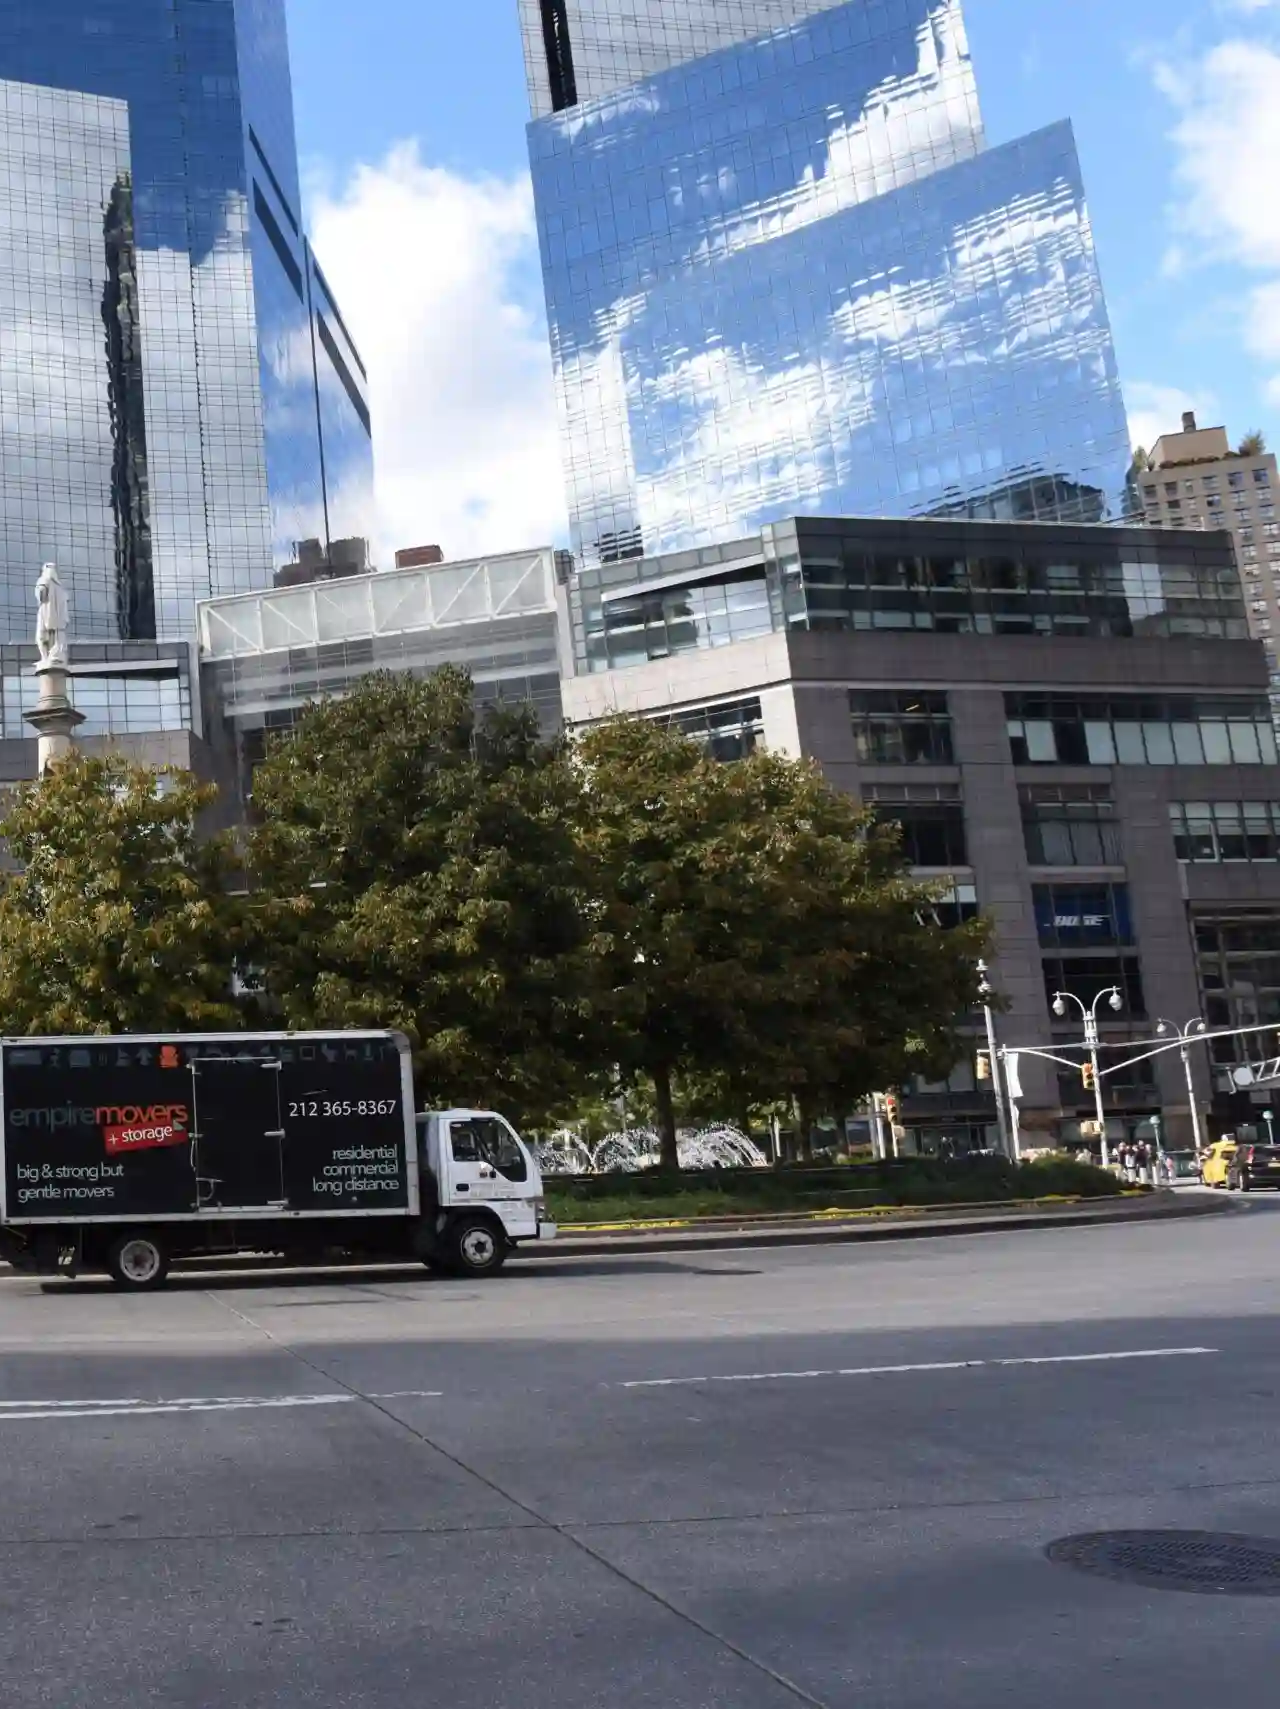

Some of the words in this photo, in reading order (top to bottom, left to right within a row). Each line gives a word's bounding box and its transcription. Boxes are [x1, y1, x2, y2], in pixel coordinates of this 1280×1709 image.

[288, 1101, 318, 1117] 212
[322, 1099, 396, 1116] 365-8367
[121, 1124, 173, 1143] storage
[332, 1143, 398, 1160] residential
[17, 1164, 39, 1182] big
[41, 1163, 54, 1179] &
[55, 1165, 99, 1181] strong
[101, 1162, 124, 1177] but
[323, 1160, 398, 1176] commercial
[18, 1184, 61, 1203] gentle
[63, 1186, 115, 1199] movers
[312, 1176, 342, 1196] long
[345, 1176, 400, 1191] distance
